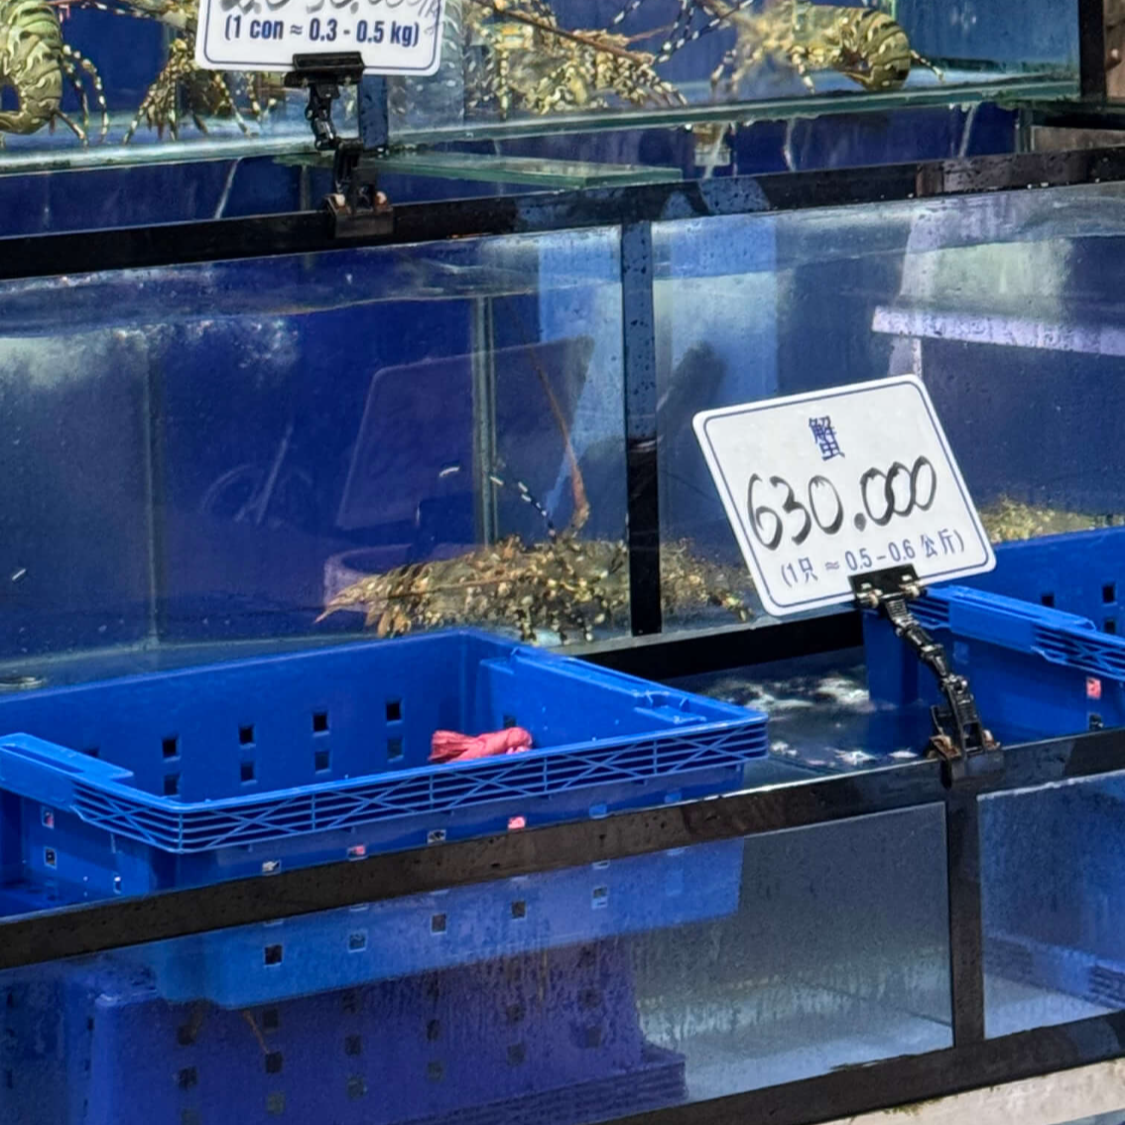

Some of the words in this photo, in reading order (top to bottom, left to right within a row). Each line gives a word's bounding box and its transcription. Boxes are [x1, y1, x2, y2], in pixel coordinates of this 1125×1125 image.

[224, 15, 242, 41] (1
[249, 20, 284, 40] con
[308, 18, 338, 42] 0.3
[356, 19, 385, 44] 0.5
[390, 20, 420, 48] kg)
[808, 415, 846, 461] 蟹
[747, 455, 937, 551] 630.000
[844, 547, 873, 572] 0.5
[887, 538, 916, 563] 0.6
